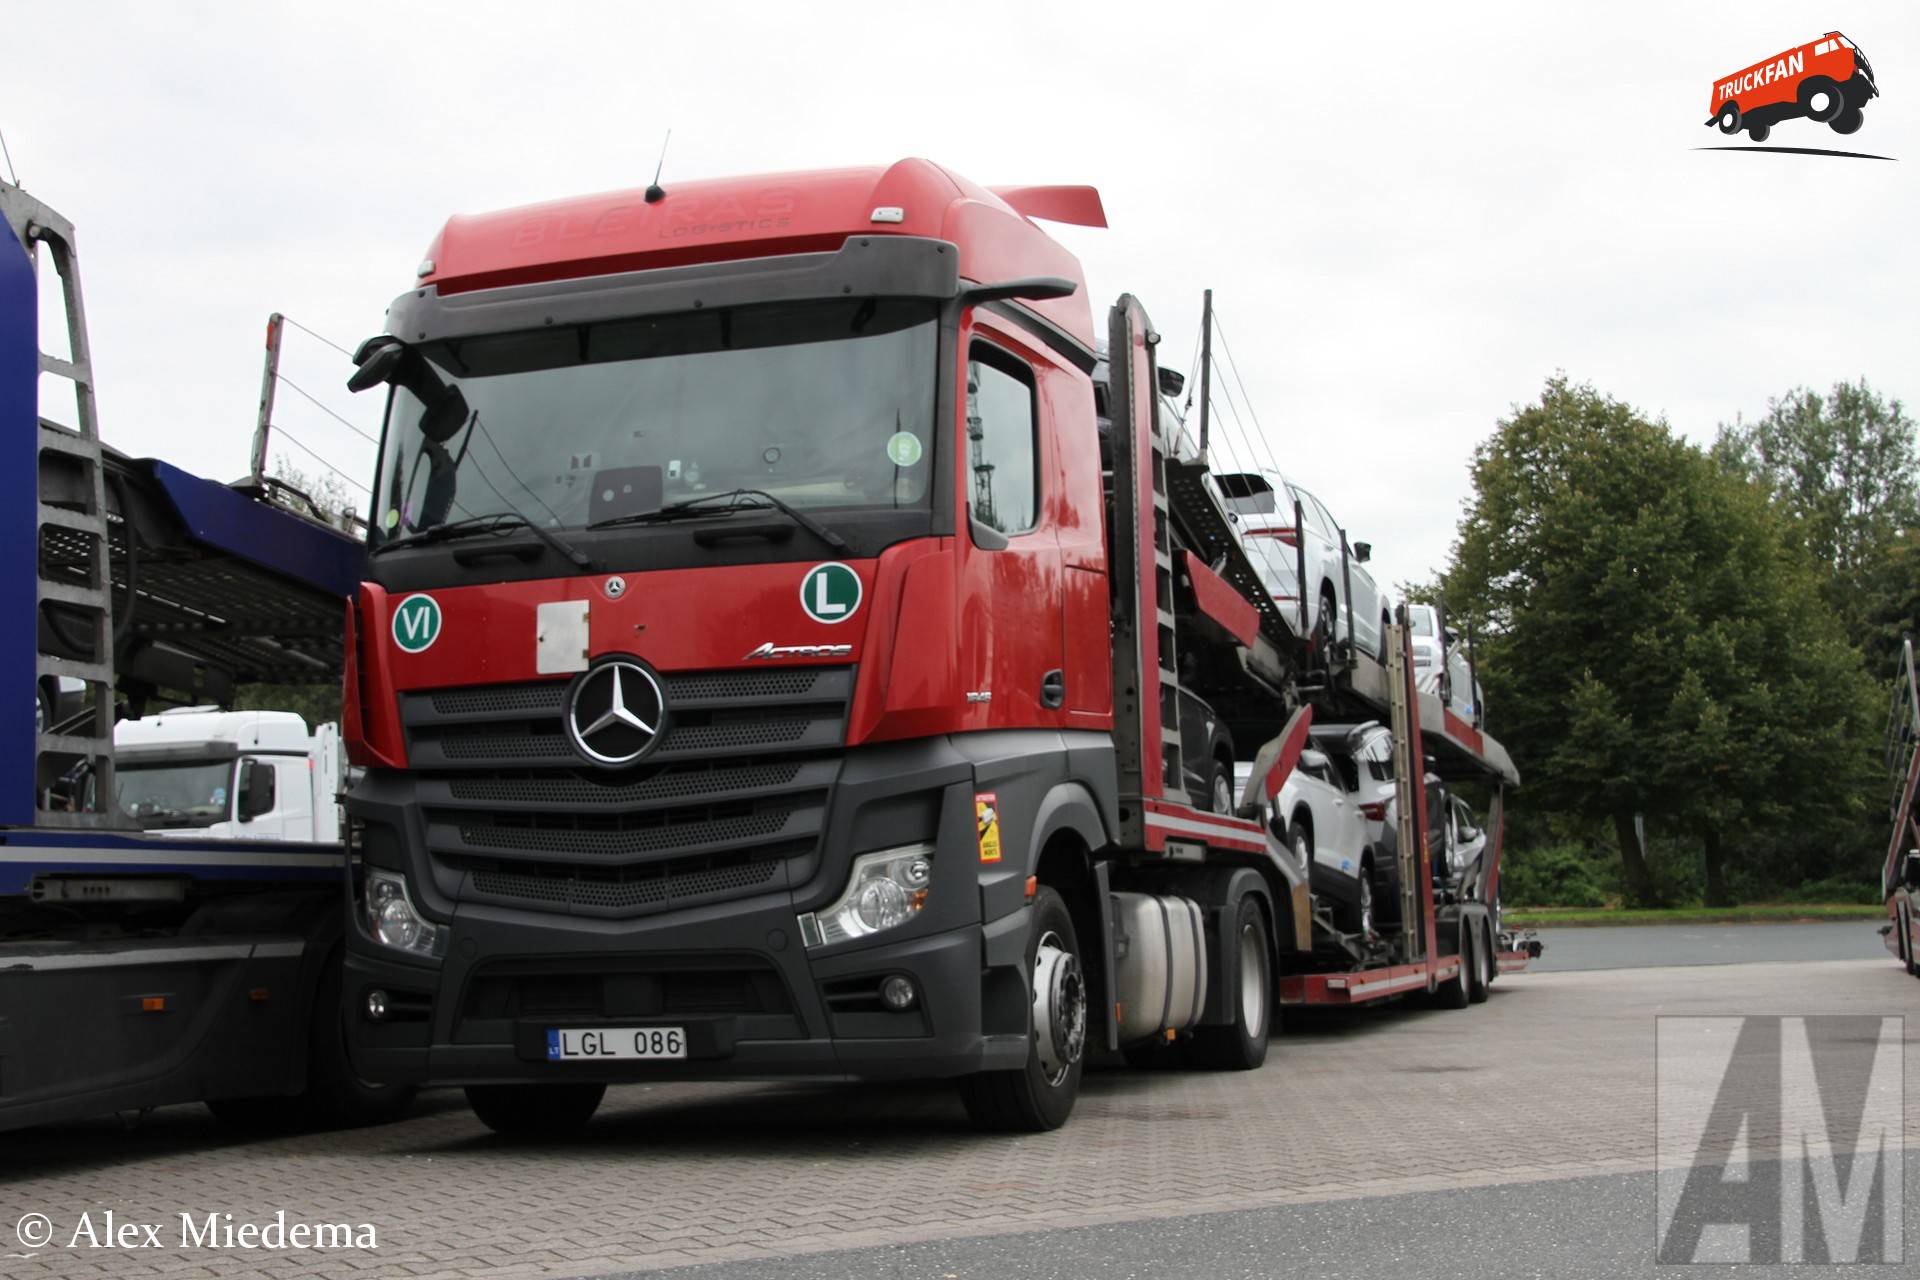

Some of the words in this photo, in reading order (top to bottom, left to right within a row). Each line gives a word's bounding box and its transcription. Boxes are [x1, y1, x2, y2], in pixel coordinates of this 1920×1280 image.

[657, 216, 792, 239] LOGISTICS
[816, 572, 846, 614] L
[402, 606, 430, 640] VI
[563, 1032, 616, 1056] LGL
[634, 1031, 682, 1054] 086
